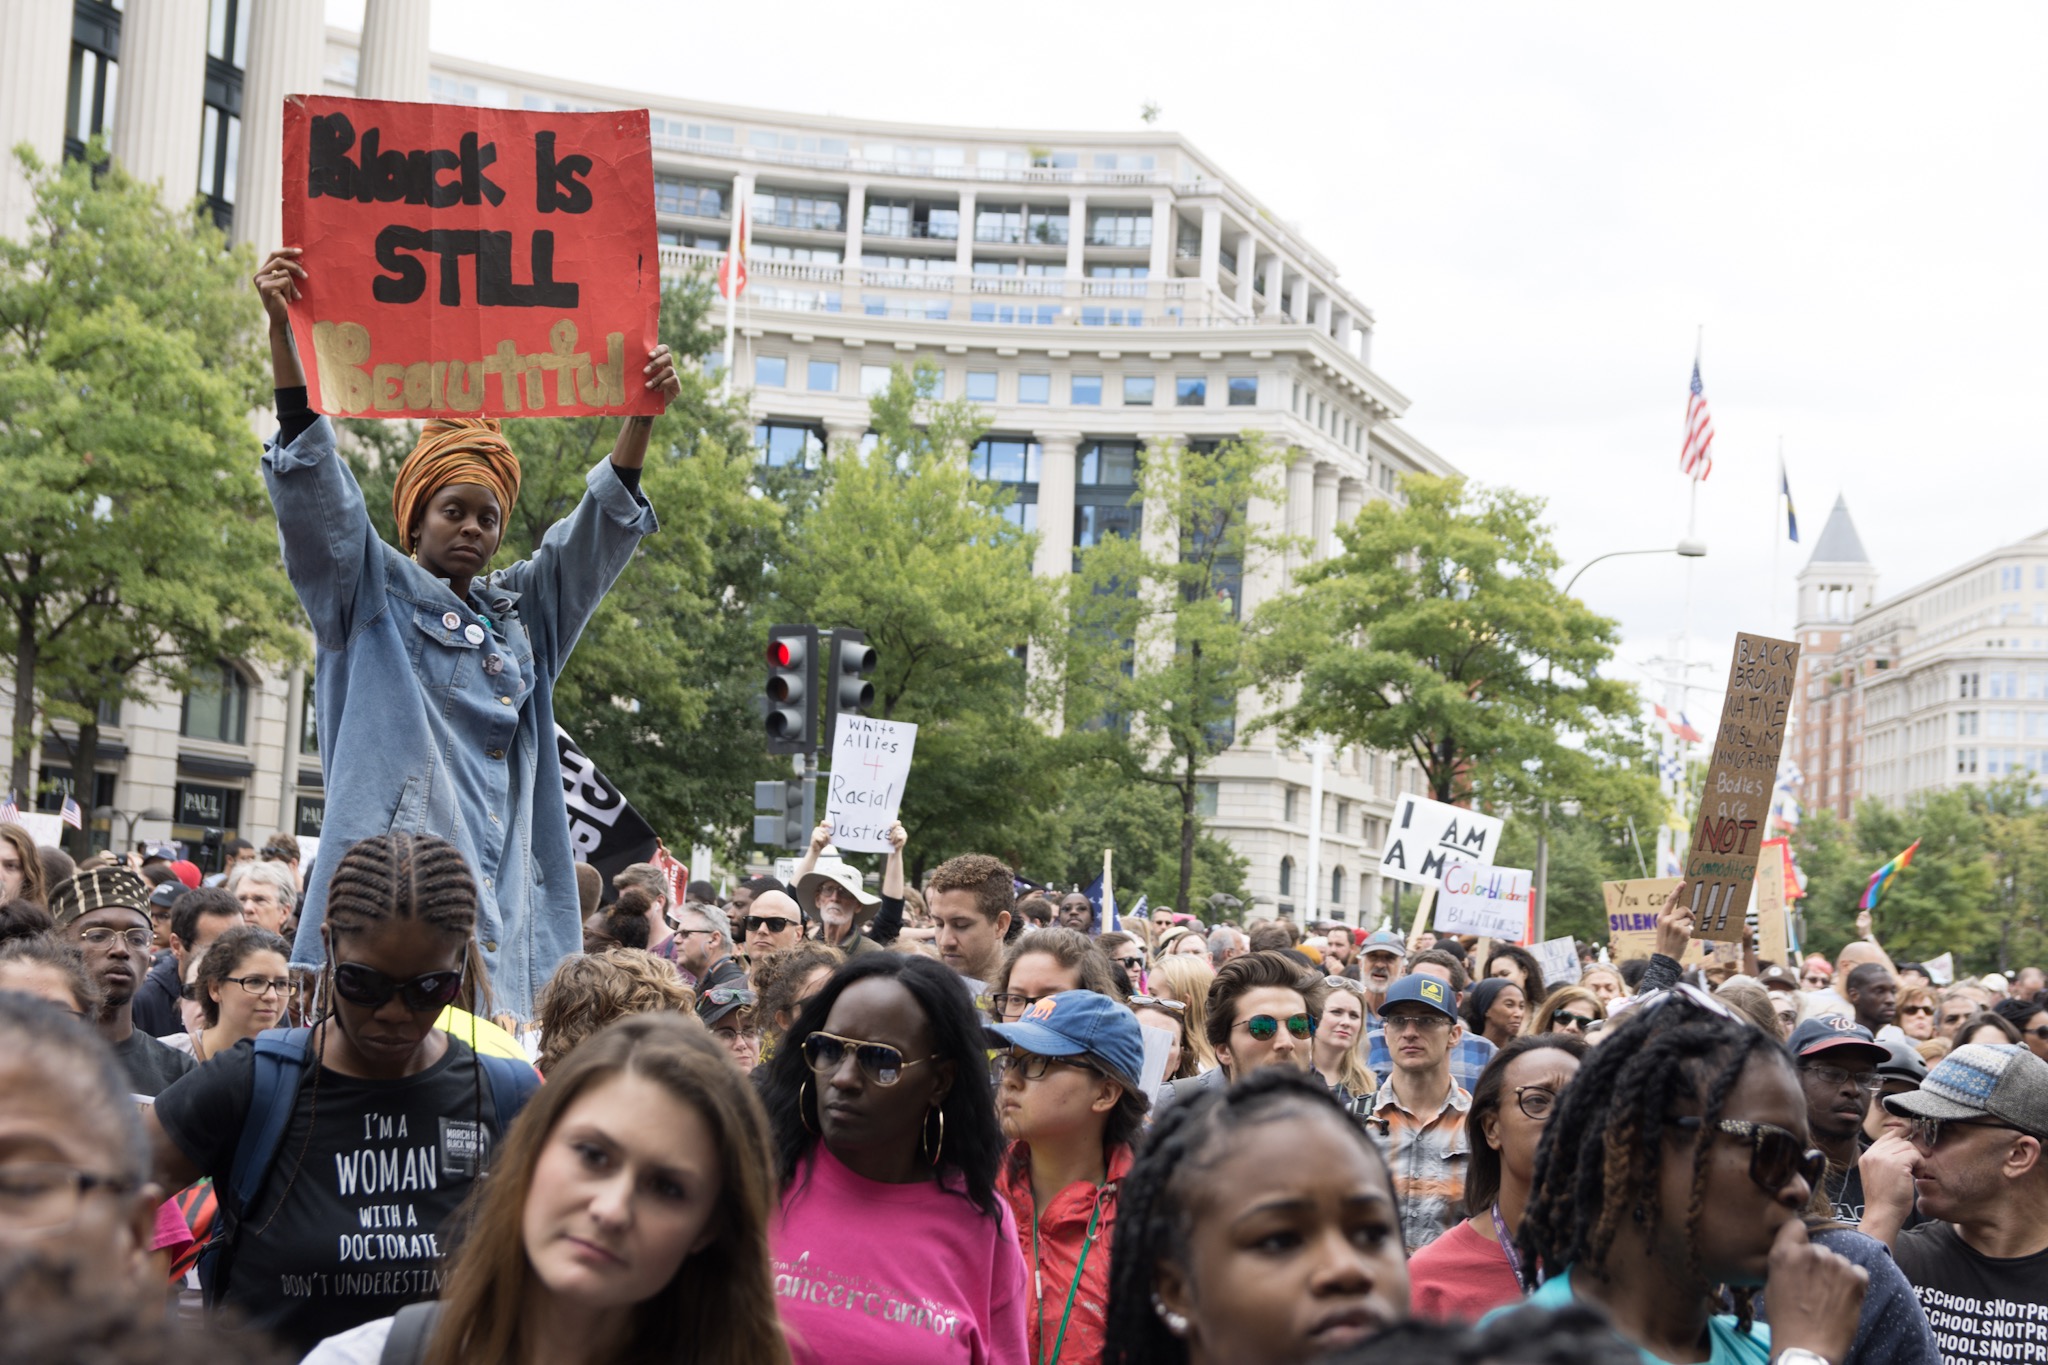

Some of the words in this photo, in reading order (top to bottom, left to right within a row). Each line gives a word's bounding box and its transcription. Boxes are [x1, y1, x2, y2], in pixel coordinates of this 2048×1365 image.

[308, 112, 506, 208] Black
[535, 130, 593, 214] Is
[372, 224, 579, 308] STILL
[311, 318, 626, 415] Beautiful
[1738, 638, 1796, 670] BLACK
[1734, 666, 1793, 697] BROWN
[1725, 694, 1785, 727] NATIVE
[849, 718, 896, 734] White
[1719, 722, 1781, 750] MUSLIM
[843, 734, 899, 754] Allies
[863, 752, 884, 781] 4
[1713, 751, 1781, 772] IMMIGRANT
[831, 774, 894, 810] Racial
[1717, 771, 1764, 798] Bodies
[829, 810, 892, 841] Justice
[1718, 800, 1749, 821] are
[1401, 801, 1415, 829] I
[1441, 817, 1487, 852] AM
[1699, 815, 1757, 855] NOT
[1383, 839, 1406, 870] A
[1689, 857, 1756, 881] Commodities
[398, 1114, 408, 1138] A
[335, 1145, 438, 1196] WOMAN
[358, 1204, 402, 1228] WITH
[406, 1203, 418, 1227] A
[339, 1232, 447, 1262] DOCTORATE.
[335, 1269, 450, 1296] UNDERESTIM
